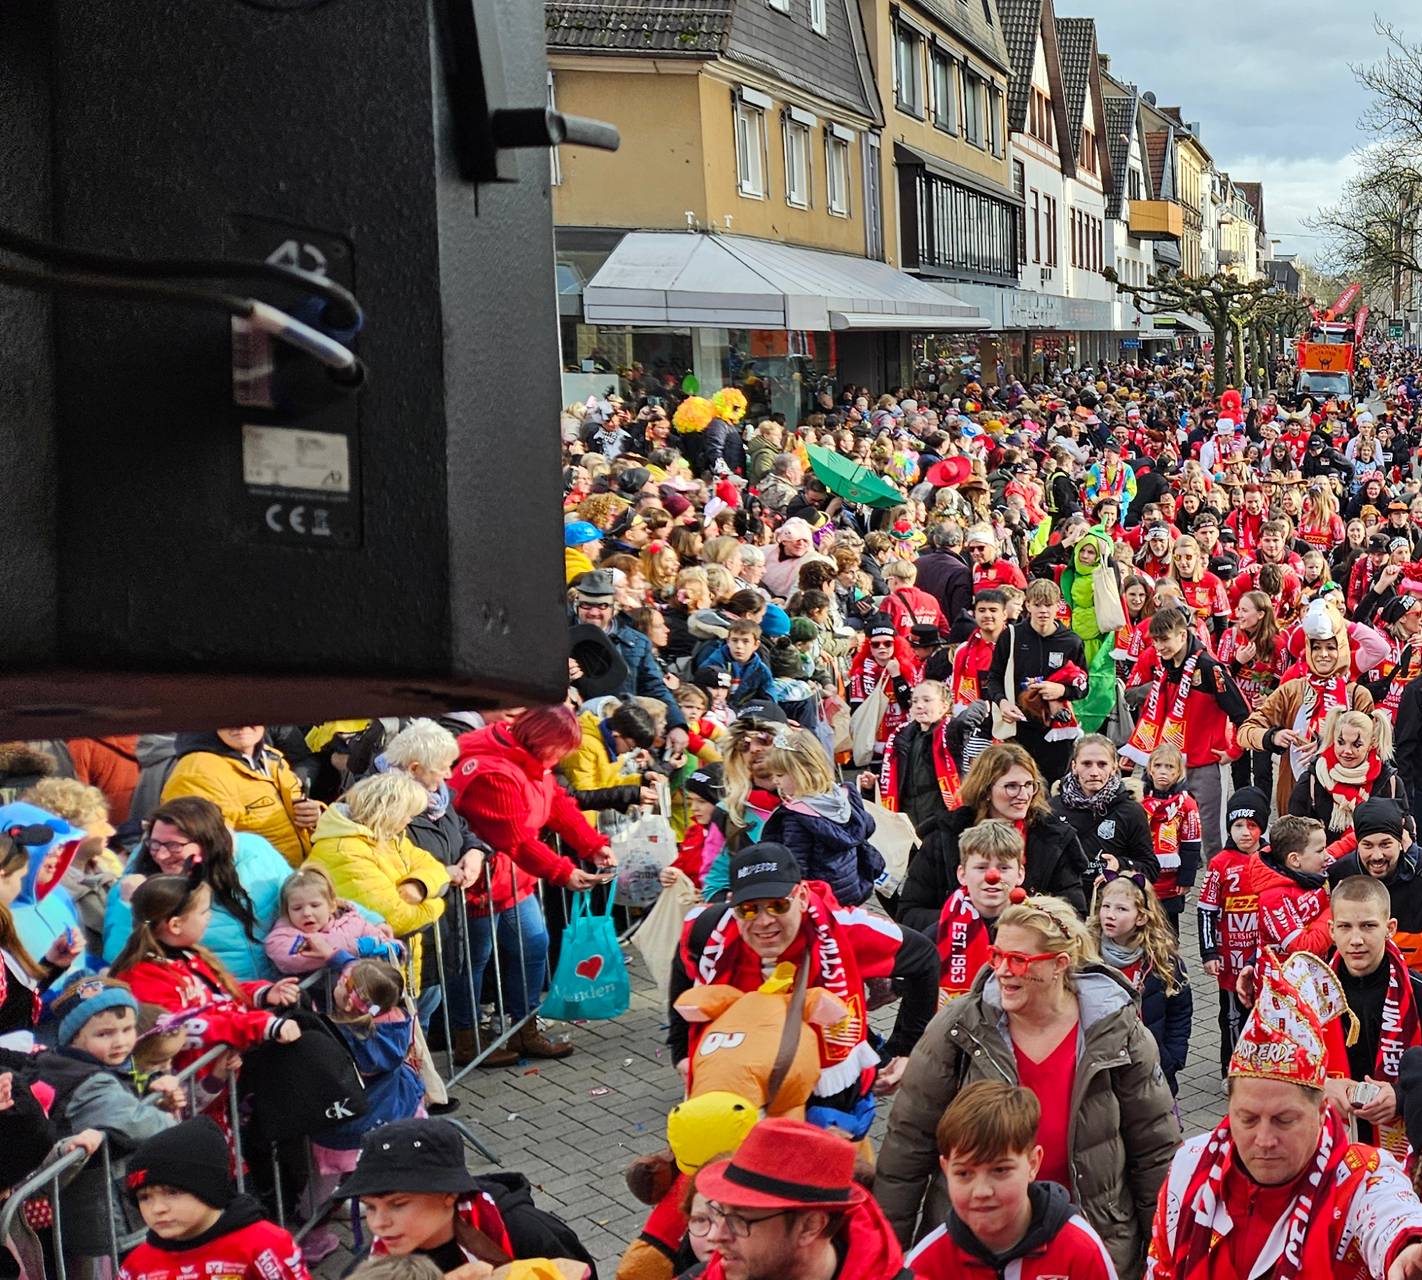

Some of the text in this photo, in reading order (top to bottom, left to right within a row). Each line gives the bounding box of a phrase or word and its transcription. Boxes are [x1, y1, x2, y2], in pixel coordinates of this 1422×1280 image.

[1227, 873, 1240, 892] 2
[1299, 896, 1320, 920] 23
[951, 922, 967, 984] EST. 1963
